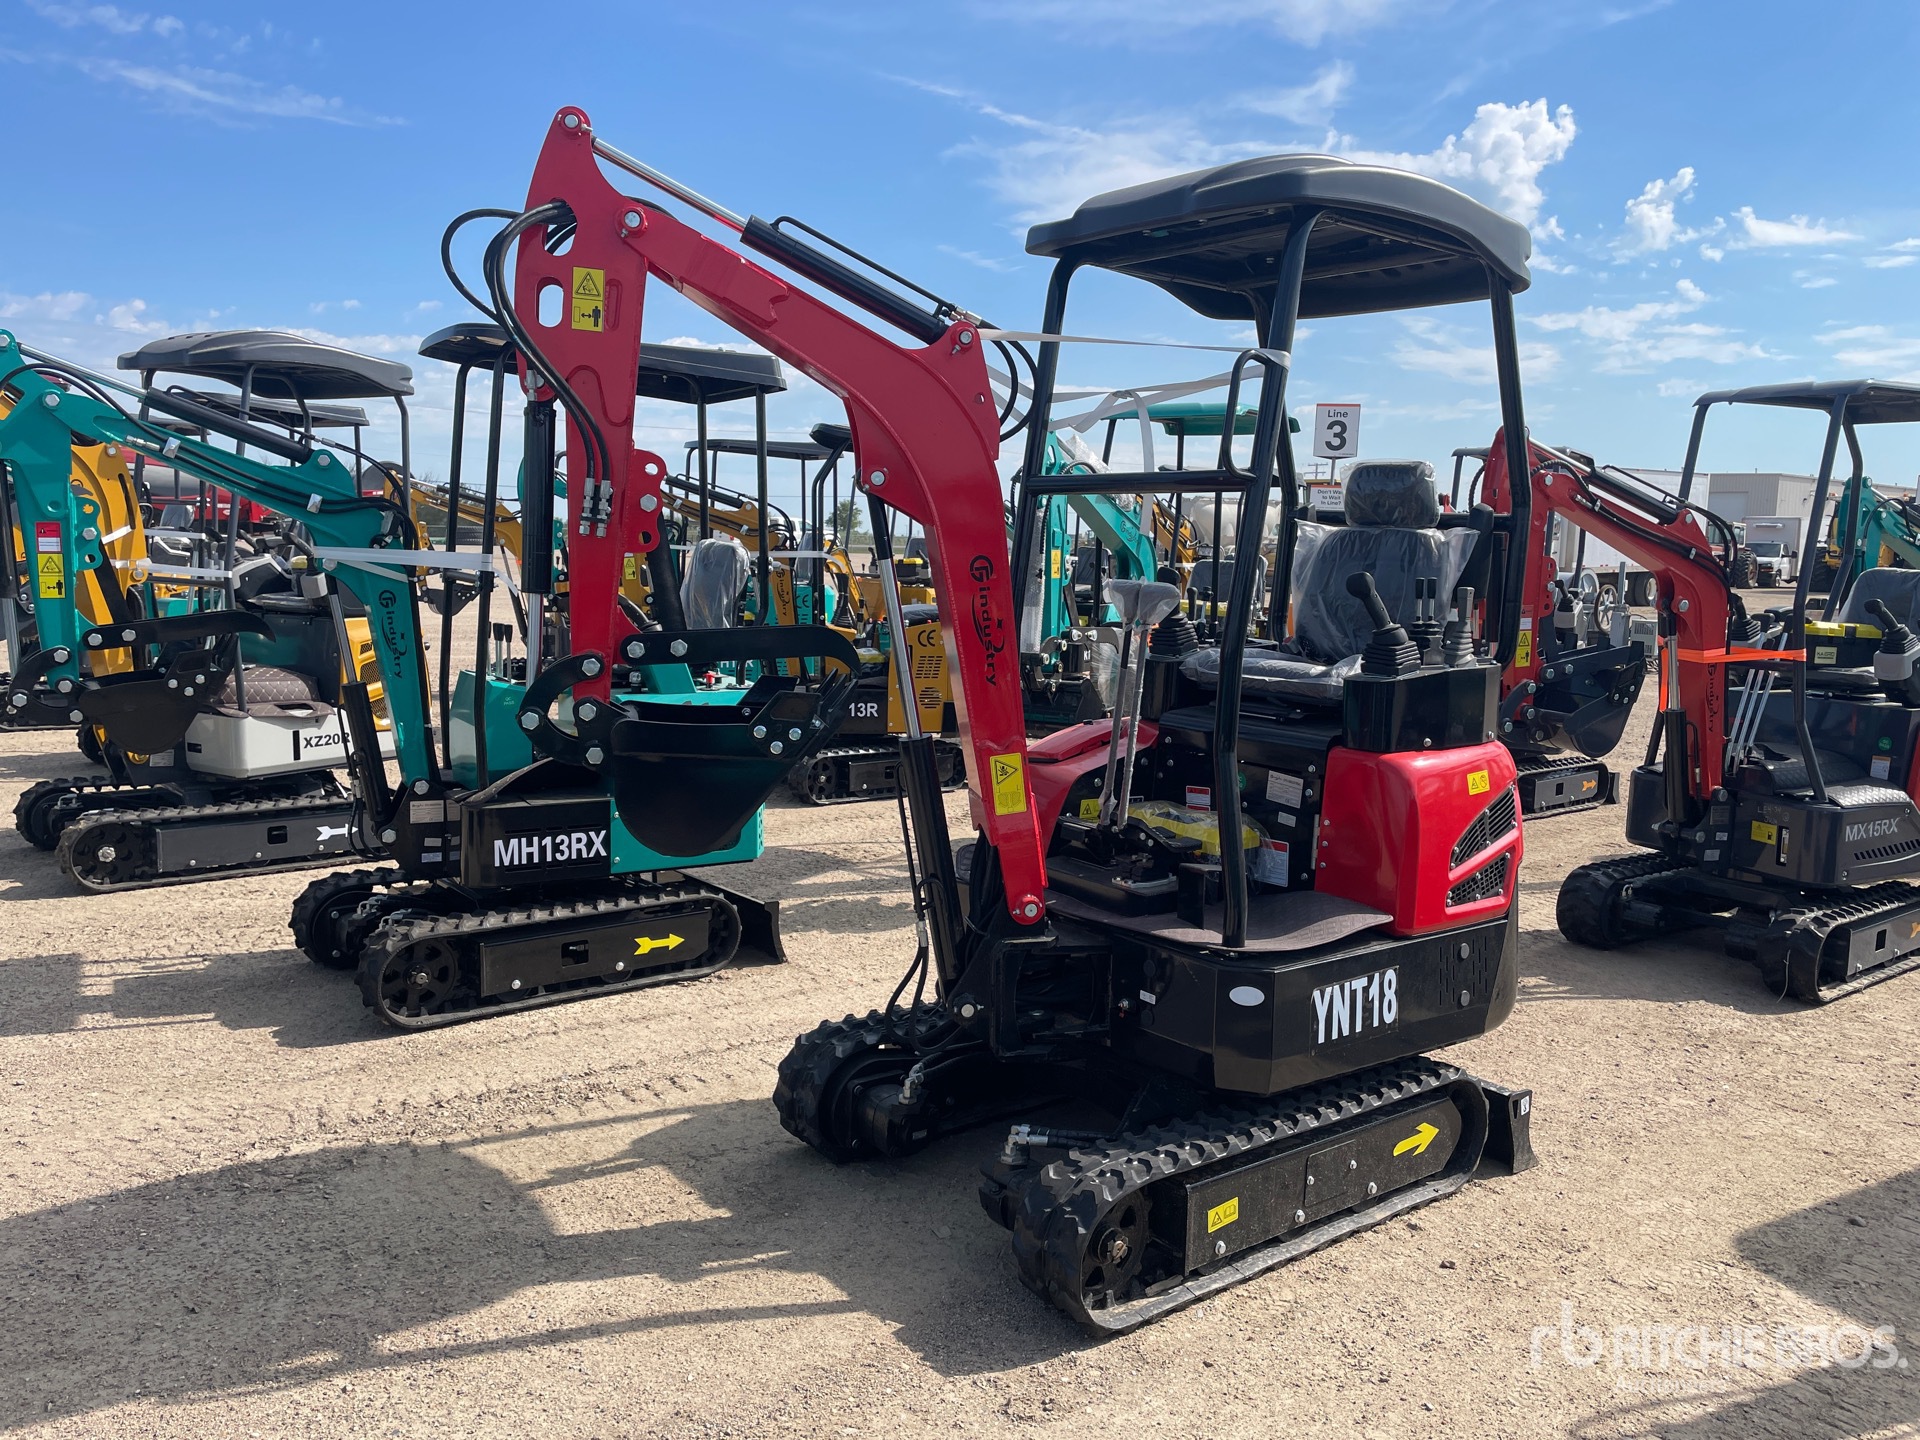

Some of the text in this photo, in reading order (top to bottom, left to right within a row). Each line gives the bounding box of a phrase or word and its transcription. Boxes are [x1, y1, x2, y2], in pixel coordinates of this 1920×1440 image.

[1327, 409, 1348, 418] Line
[1325, 420, 1347, 451] 3
[917, 629, 937, 647] CE
[1845, 817, 1900, 842] MX15RX
[494, 830, 607, 867] MH13RX
[1313, 969, 1397, 1044] YNT18
